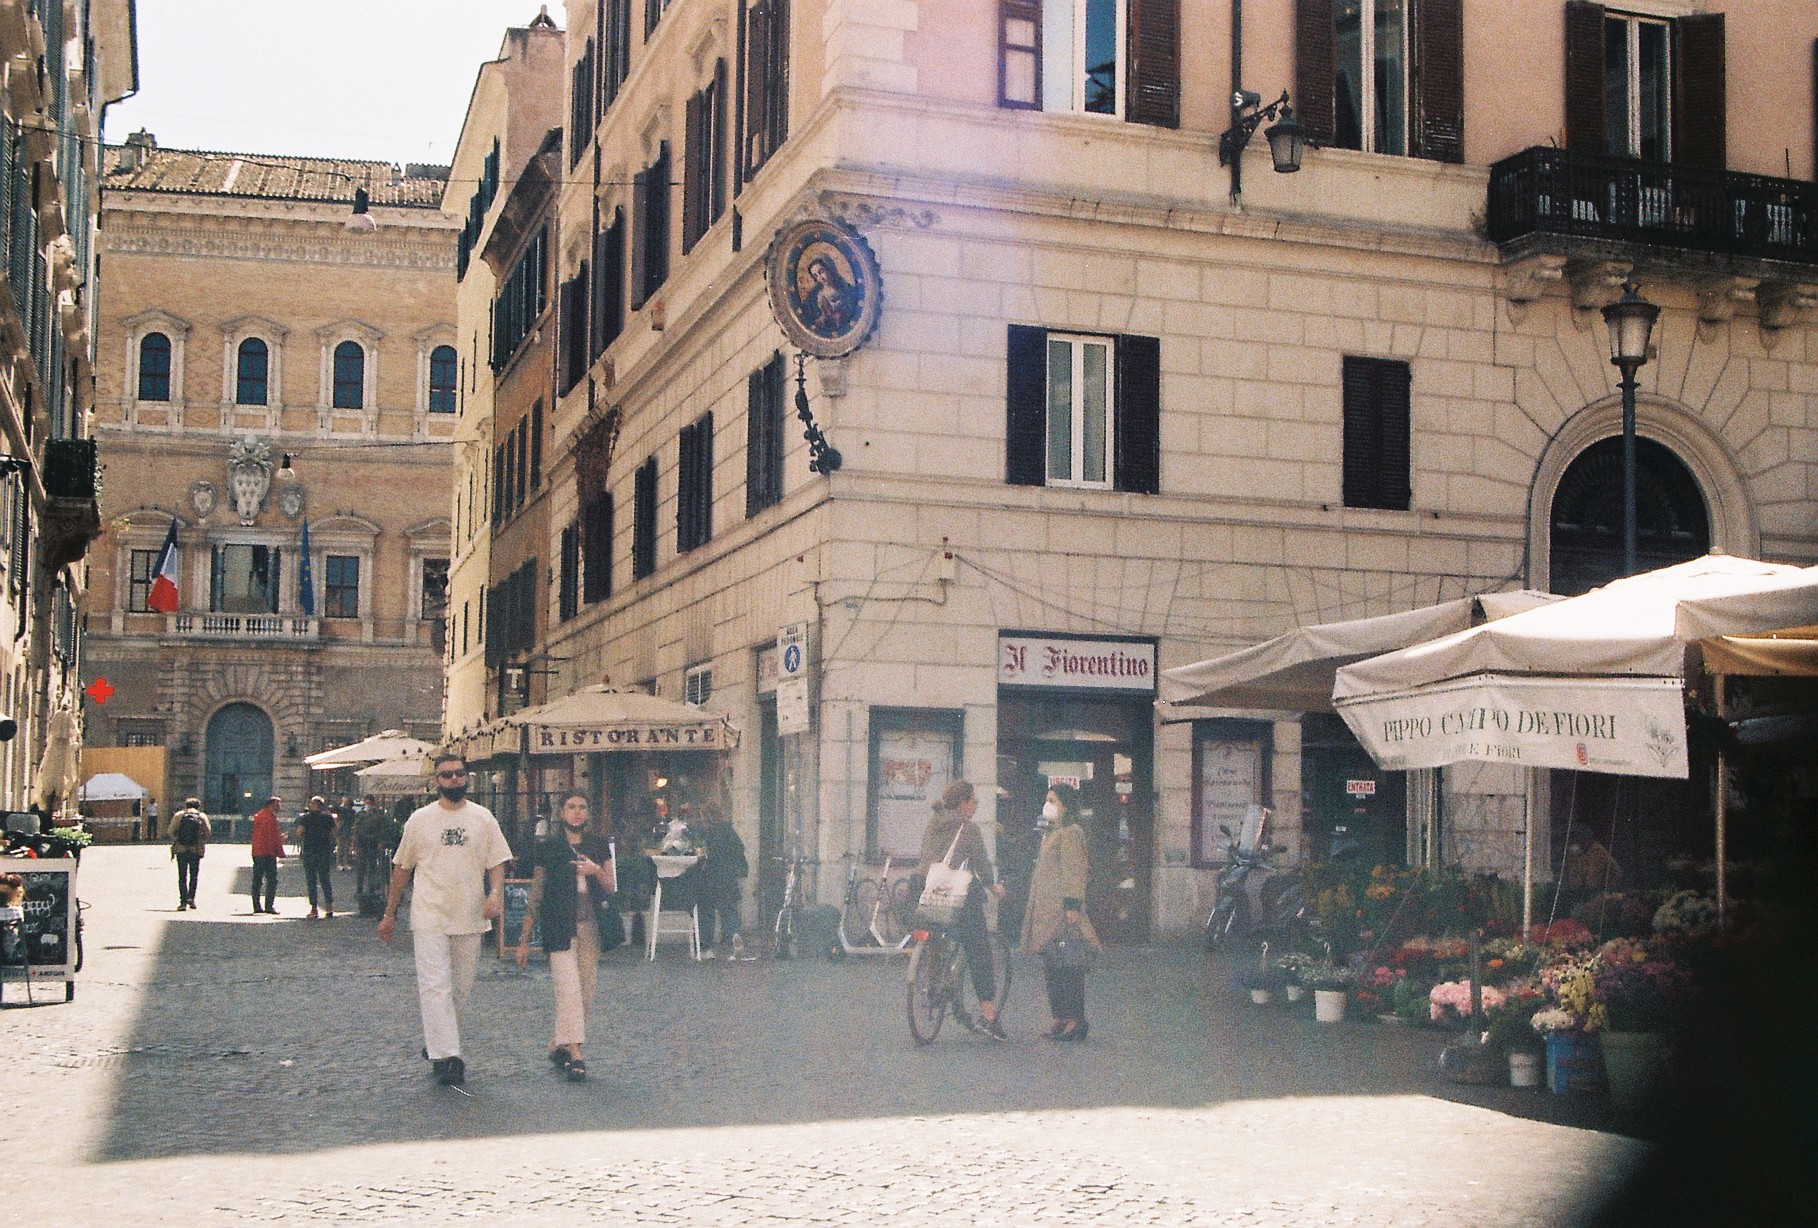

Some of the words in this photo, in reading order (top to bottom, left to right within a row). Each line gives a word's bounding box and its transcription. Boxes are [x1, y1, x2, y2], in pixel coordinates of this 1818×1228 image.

[1004, 644, 1027, 677] Il
[1042, 646, 1149, 678] Fiorentino
[506, 668, 523, 689] T
[541, 728, 715, 746] RISTORANTE
[1383, 717, 1432, 741] PIPPO
[1553, 712, 1616, 739] FIORI
[1348, 782, 1374, 792] ENTRATA
[22, 893, 55, 917] appy
